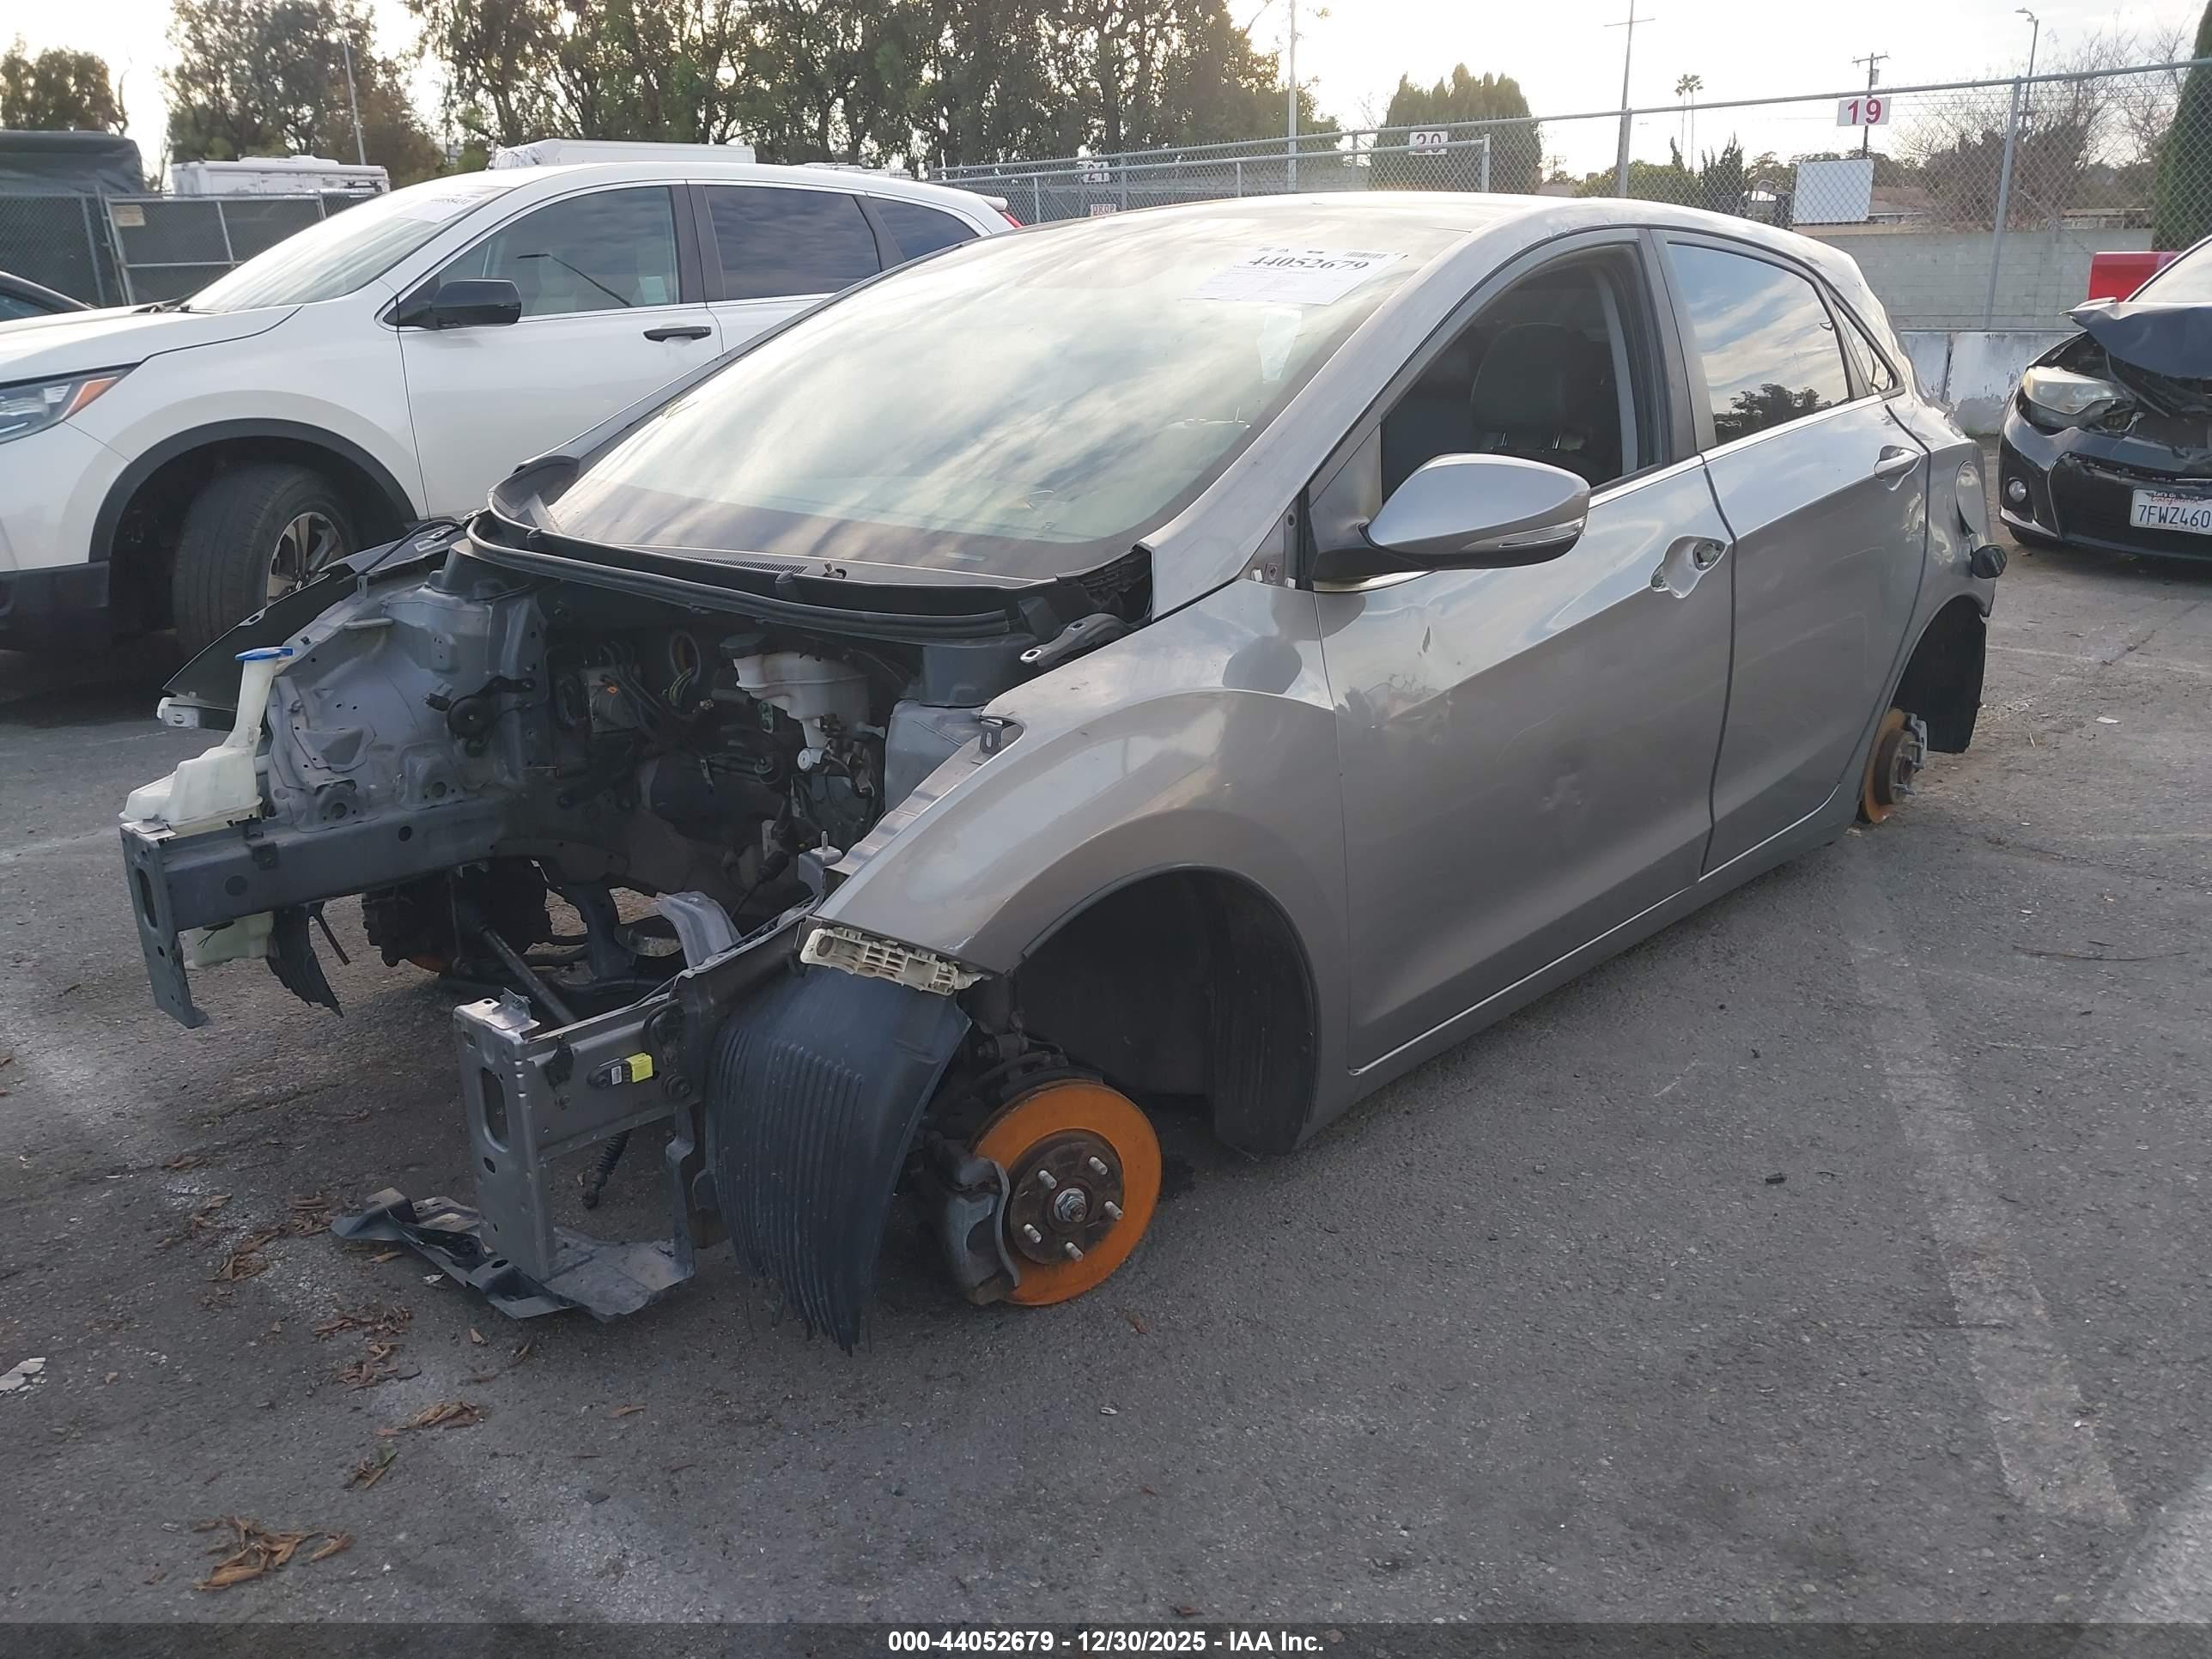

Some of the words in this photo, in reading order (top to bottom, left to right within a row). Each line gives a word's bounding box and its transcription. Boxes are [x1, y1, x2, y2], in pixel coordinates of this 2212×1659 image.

[1848, 99, 1881, 125] 19
[1087, 163, 1104, 181] 21
[1092, 204, 1115, 214] DROP
[1249, 255, 1370, 270] 44052679
[2138, 504, 2211, 528] 7FWZ460
